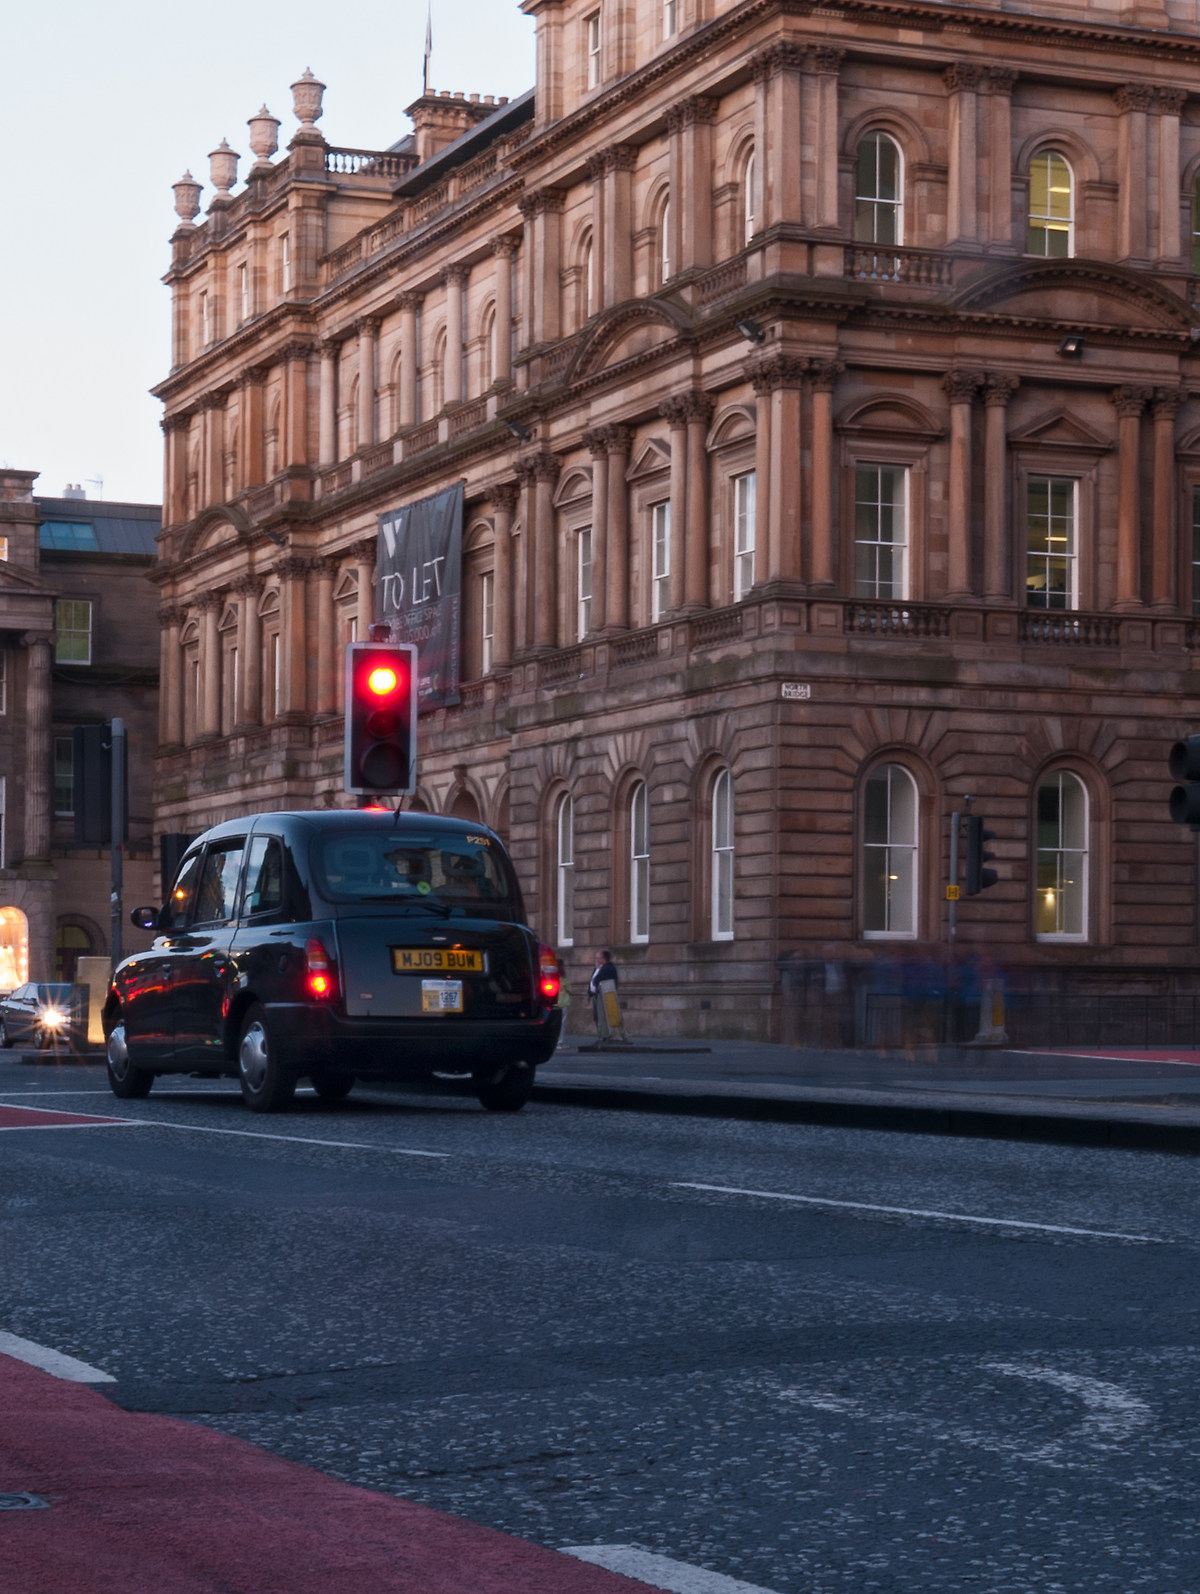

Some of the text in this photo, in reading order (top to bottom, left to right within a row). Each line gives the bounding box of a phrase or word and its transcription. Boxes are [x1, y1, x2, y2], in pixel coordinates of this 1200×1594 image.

[381, 555, 445, 612] TO LET
[402, 952, 475, 967] MJ09 BUW
